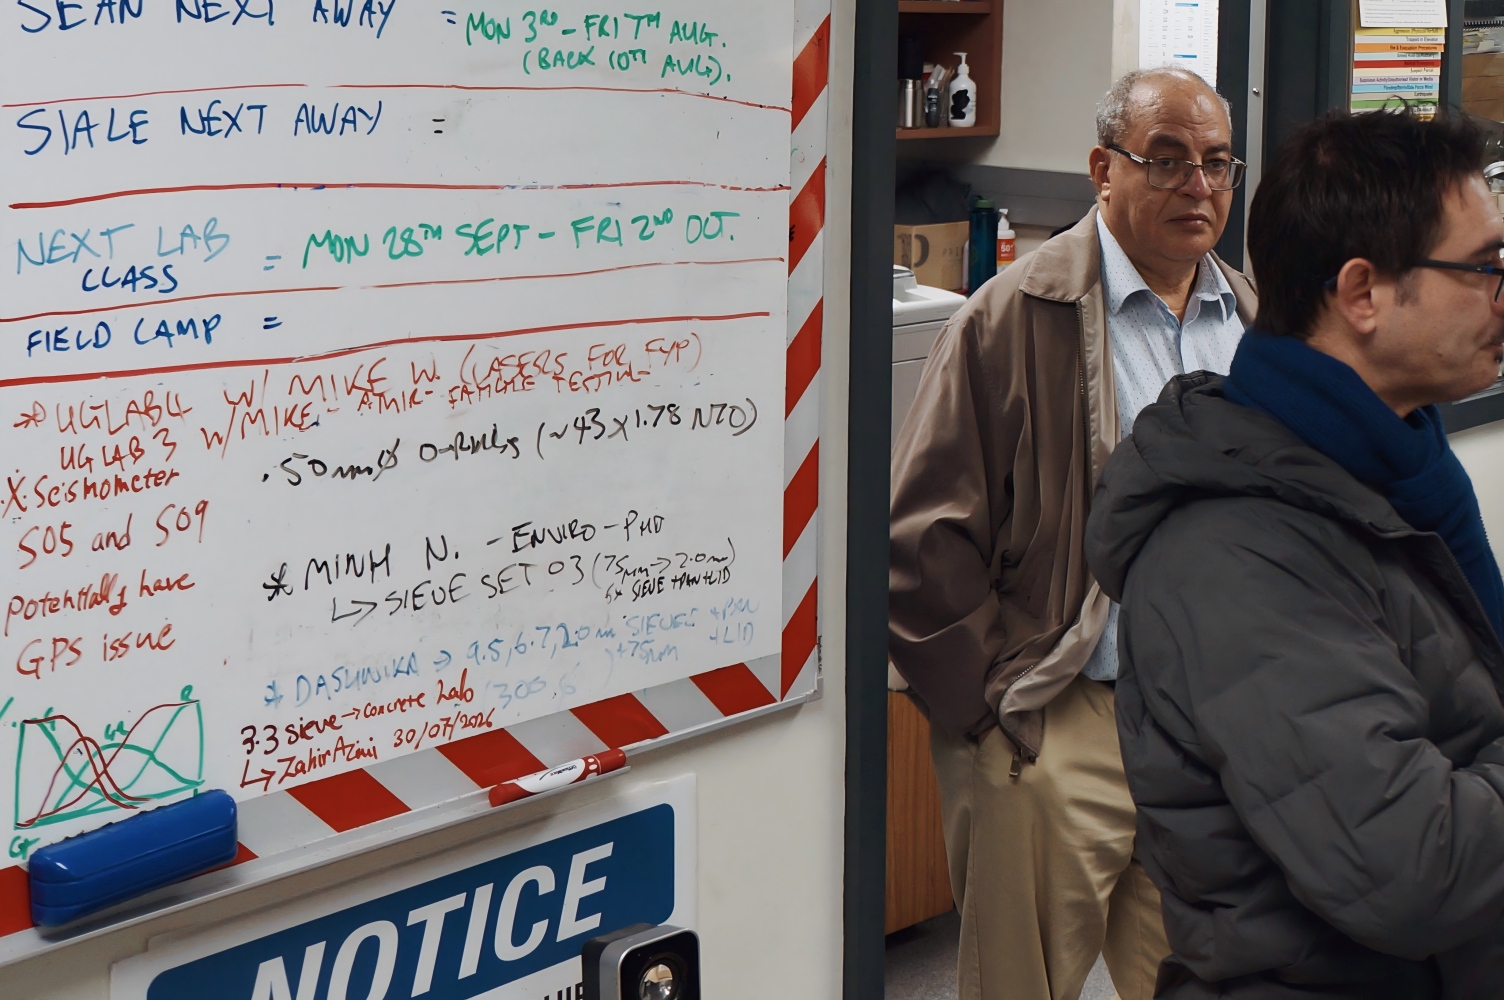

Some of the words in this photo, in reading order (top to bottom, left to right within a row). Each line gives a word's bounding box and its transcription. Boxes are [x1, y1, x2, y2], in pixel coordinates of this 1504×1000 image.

[466, 11, 511, 46] MON
[583, 14, 618, 41] FRI
[522, 45, 596, 75] (BACK
[16, 108, 149, 156] SIALE
[181, 100, 268, 137] NEXT
[294, 100, 382, 136] AWAY
[17, 223, 135, 275] NEXT
[156, 216, 231, 263] LAB
[303, 229, 369, 269] MON
[455, 217, 530, 256] SEPT
[570, 215, 623, 248] FRI
[81, 264, 178, 294] CLASS
[27, 320, 112, 357] FIELD
[134, 314, 221, 348] CAMP
[288, 357, 386, 401] MIKE
[588, 343, 630, 371] FOR
[60, 443, 94, 473] UG
[102, 436, 145, 471] LAB
[241, 401, 314, 439] MIKE
[34, 468, 180, 508] Seismometer
[91, 513, 132, 551] and
[139, 569, 195, 597] have
[304, 543, 390, 590] MINH
[481, 563, 538, 599] SET
[17, 637, 83, 680] GPS
[103, 623, 176, 662] issue
[393, 707, 495, 750] 30/07/2026
[248, 841, 614, 1000] NOTICE
